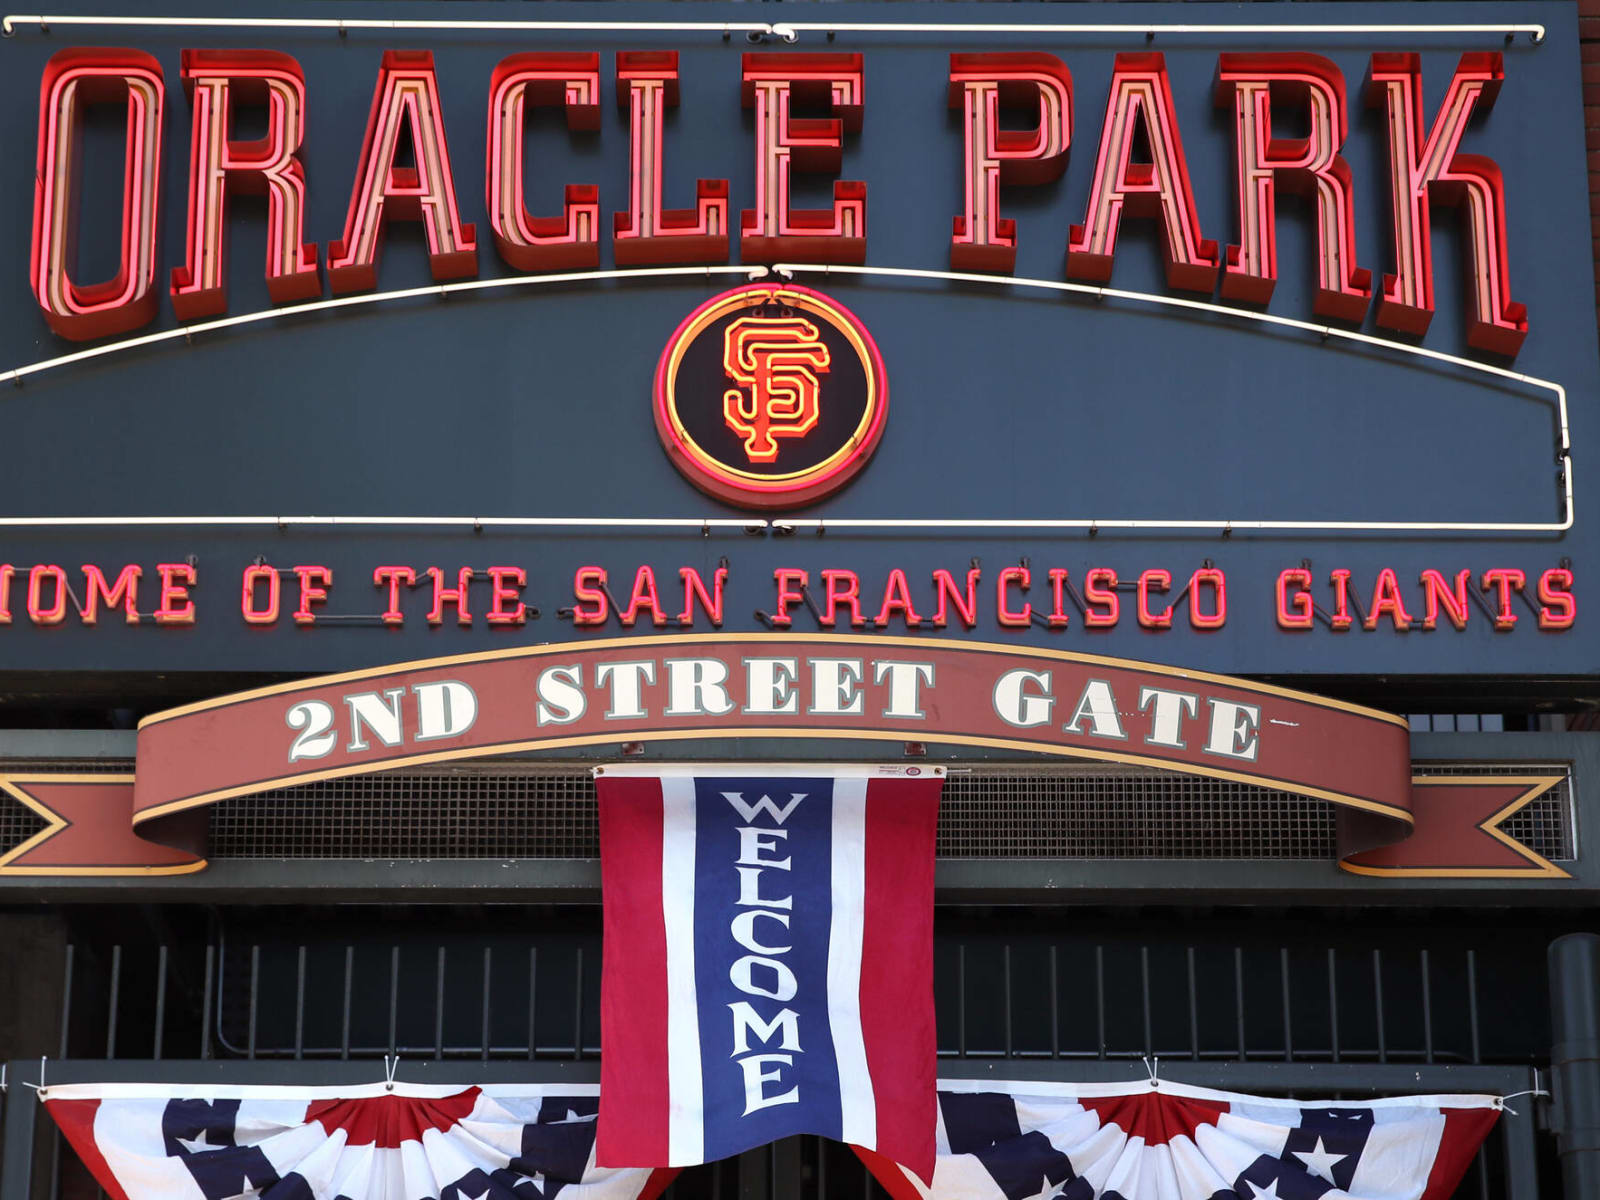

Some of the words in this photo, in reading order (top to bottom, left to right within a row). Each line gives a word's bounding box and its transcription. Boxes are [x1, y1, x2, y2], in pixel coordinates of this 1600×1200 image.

[30, 46, 866, 341] ORACLE
[949, 52, 1529, 357] PARK
[241, 563, 332, 624] OF
[373, 565, 528, 625] THE
[572, 565, 728, 626] SAN
[769, 567, 1227, 629] FRANCISCO
[1276, 567, 1576, 630] GIANTS
[285, 679, 479, 763] 2ND
[536, 656, 936, 728] STREET
[992, 667, 1262, 763] GATE
[720, 791, 809, 1118] WELCOME
